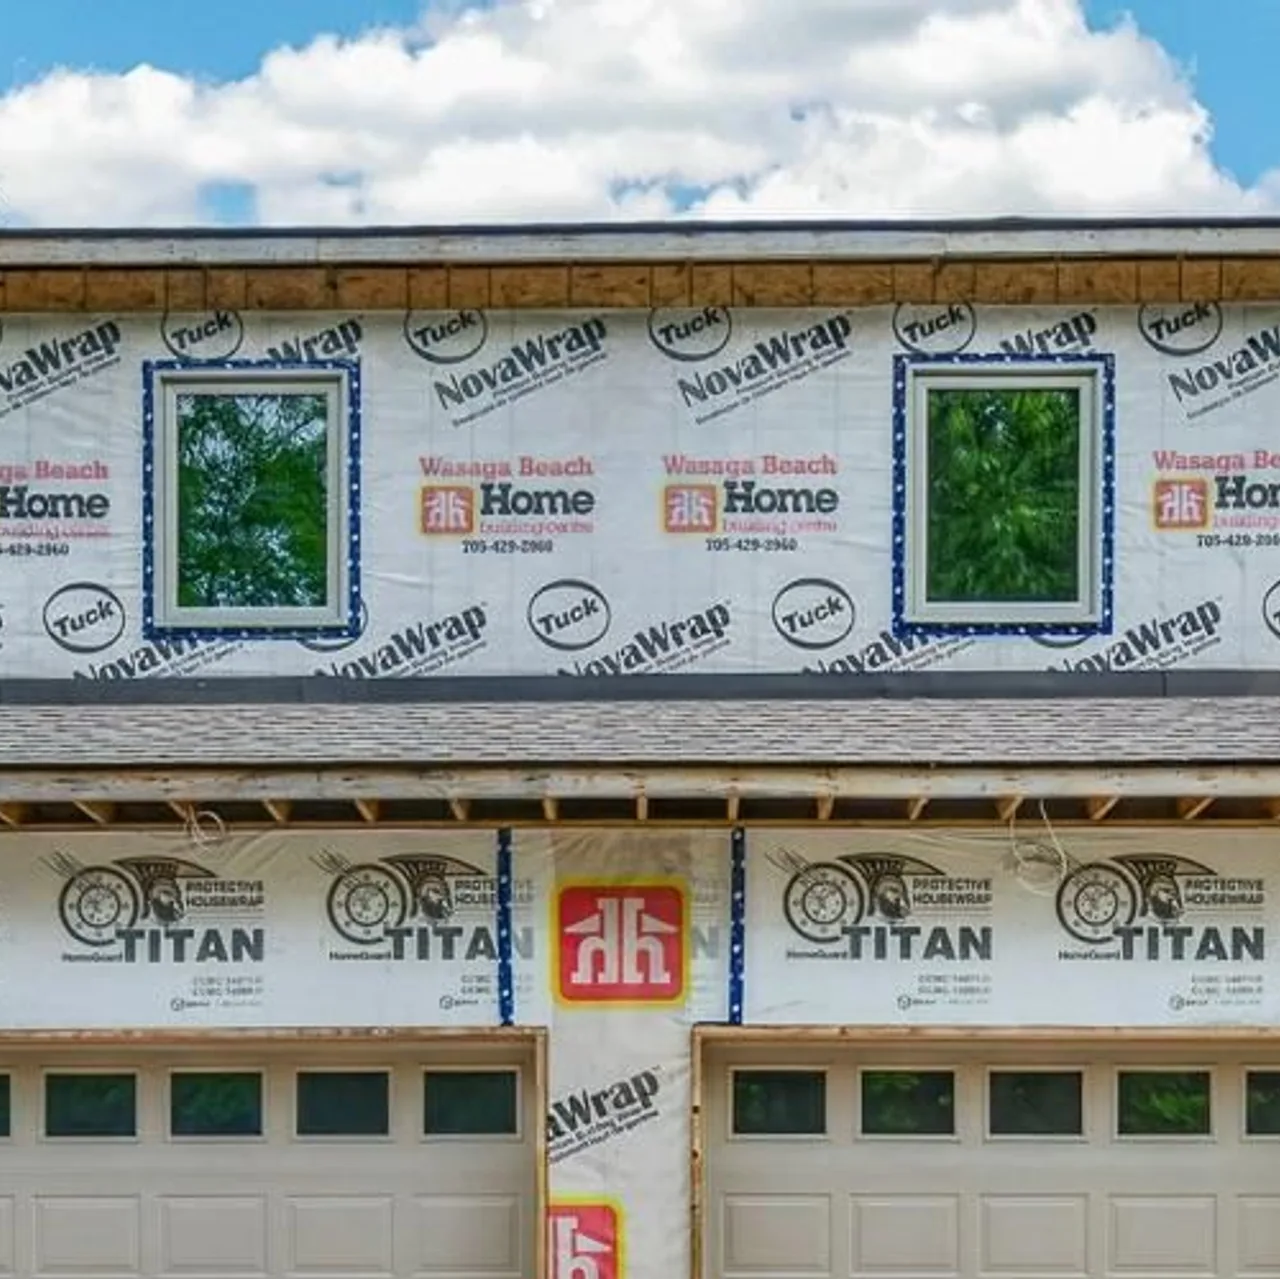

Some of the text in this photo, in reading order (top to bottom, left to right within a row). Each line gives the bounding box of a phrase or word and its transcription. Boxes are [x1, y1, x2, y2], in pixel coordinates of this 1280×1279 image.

[171, 310, 232, 349] Tuck
[414, 311, 476, 347] Tuck
[658, 307, 720, 344] Tuck
[903, 303, 966, 343] Tuck
[1149, 303, 1210, 340] Tuck
[433, 317, 607, 410] NovaWrap
[677, 315, 852, 407] NovaWrap
[35, 460, 109, 480] Beach
[420, 455, 594, 478] Wasaga Beach
[664, 454, 837, 477] Wasaga Beach
[1154, 450, 1245, 472] Wasaga
[480, 483, 595, 515] Home
[723, 481, 839, 513] Home
[53, 600, 115, 638] Tuck
[537, 597, 599, 635] Tuck
[782, 595, 844, 633] Tuck
[913, 878, 992, 891] PROTECTIVE
[913, 893, 992, 904] HOUSEWRAP
[115, 928, 264, 963] TITAN
[841, 926, 992, 960] TITAN
[1113, 926, 1264, 961] TITAN
